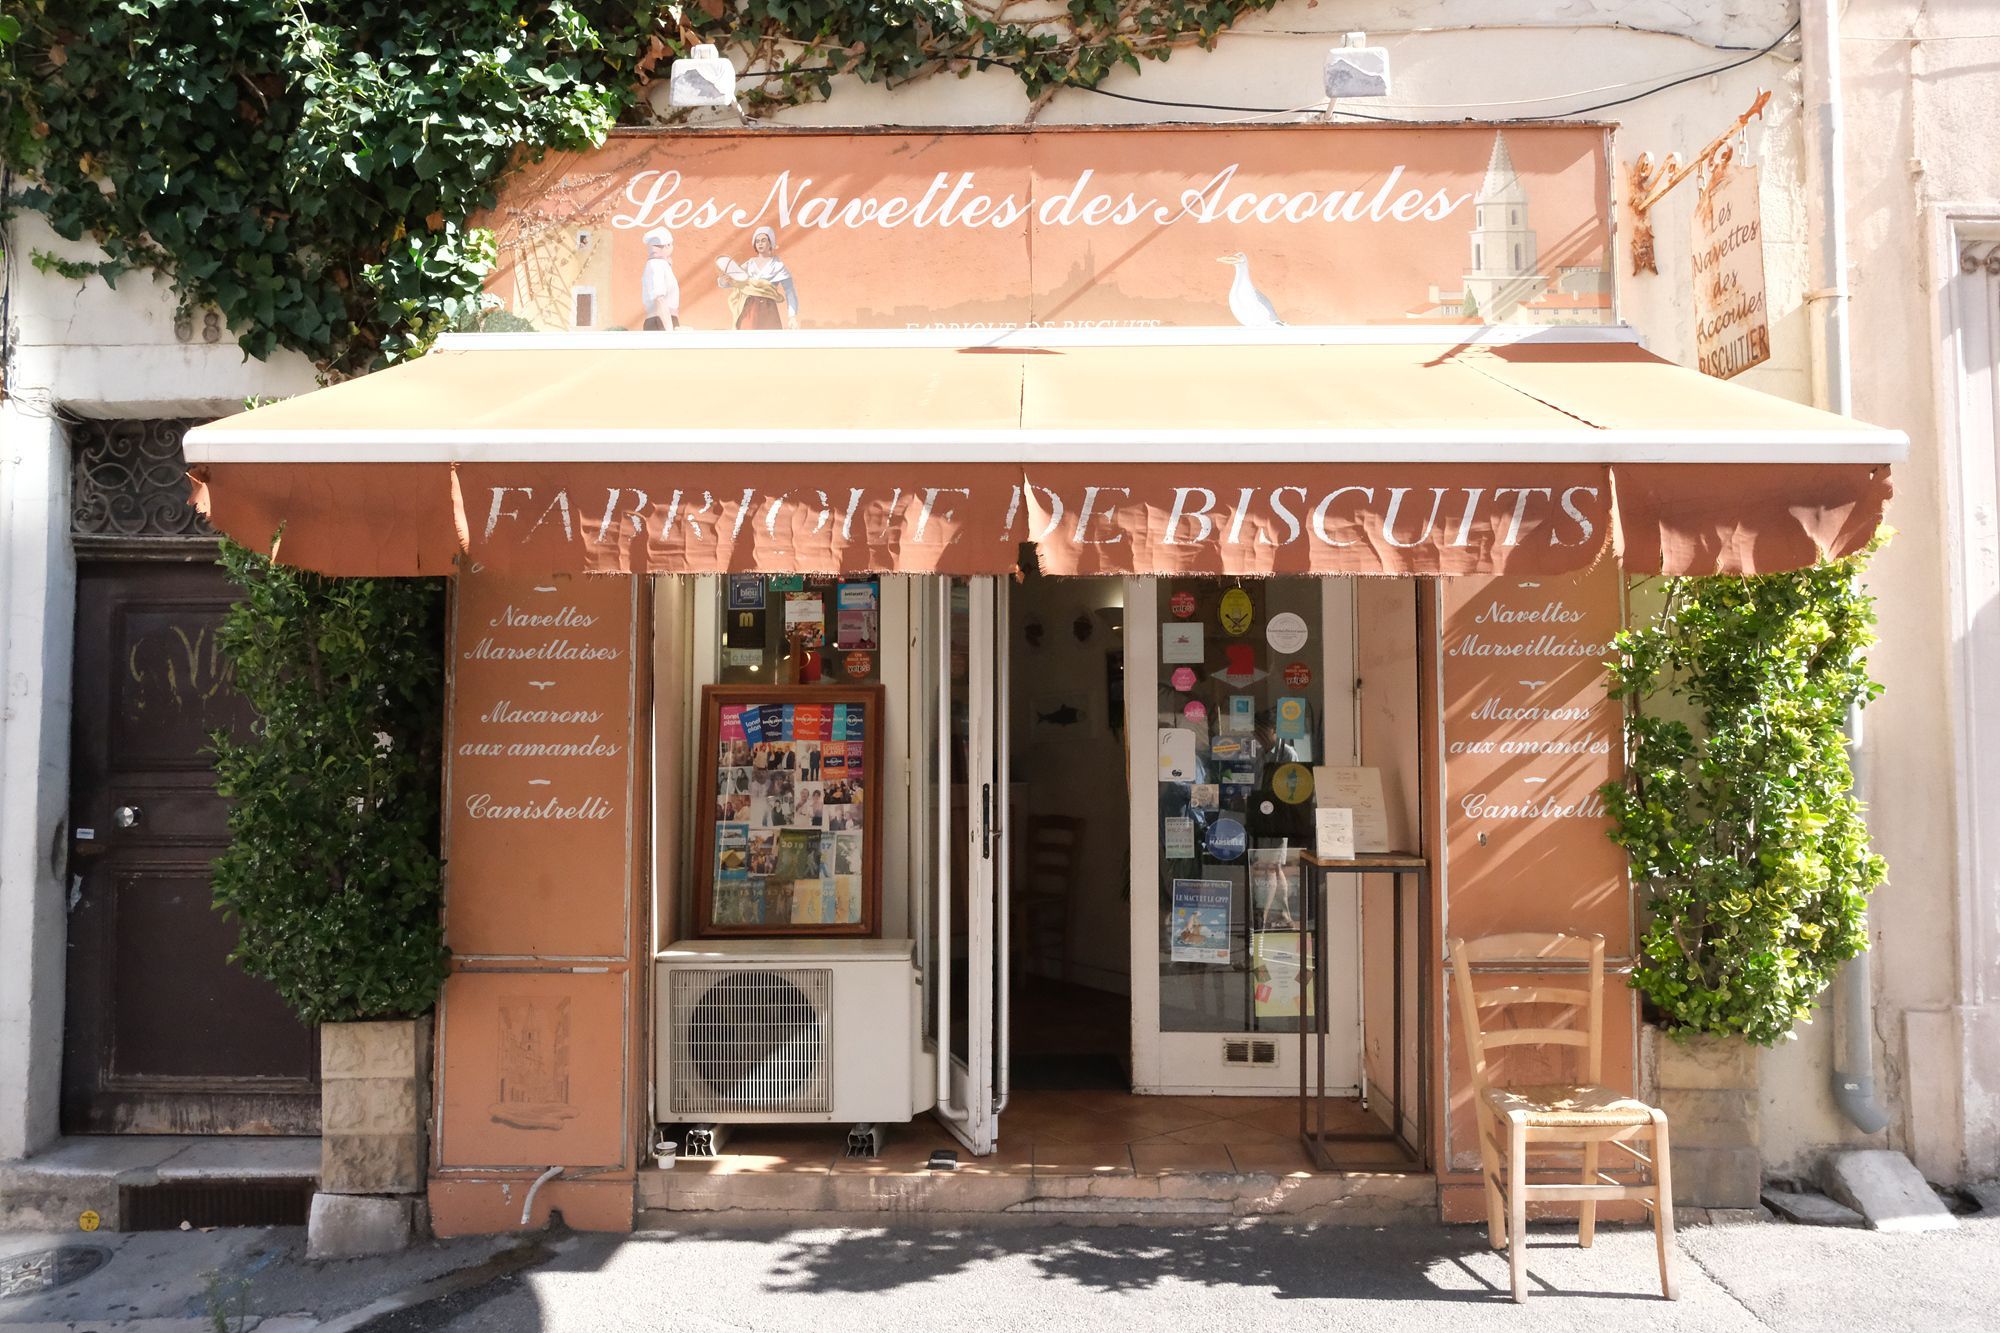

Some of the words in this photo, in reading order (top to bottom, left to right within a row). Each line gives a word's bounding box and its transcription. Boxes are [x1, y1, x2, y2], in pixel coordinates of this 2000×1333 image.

[610, 169, 736, 229] Les
[732, 169, 1034, 229] Navettes
[1038, 169, 1158, 226] des
[1154, 163, 1473, 225] Accoules
[1691, 219, 1760, 276] Navettes
[1713, 269, 1739, 299] des
[1697, 291, 1763, 344] Accoules
[1163, 485, 1600, 547] BISCUITS
[489, 605, 599, 628] Navettes
[1475, 601, 1587, 624] Navettes
[463, 638, 624, 660] Marseillaises
[1450, 634, 1611, 657] Marseillaises
[481, 700, 605, 723] Macarons
[1470, 697, 1593, 721] Macarons
[458, 741, 504, 756] aux
[507, 735, 622, 757] amandes
[1450, 739, 1498, 754] aux
[1499, 732, 1616, 754] amandes
[466, 793, 614, 820] Canistrelli
